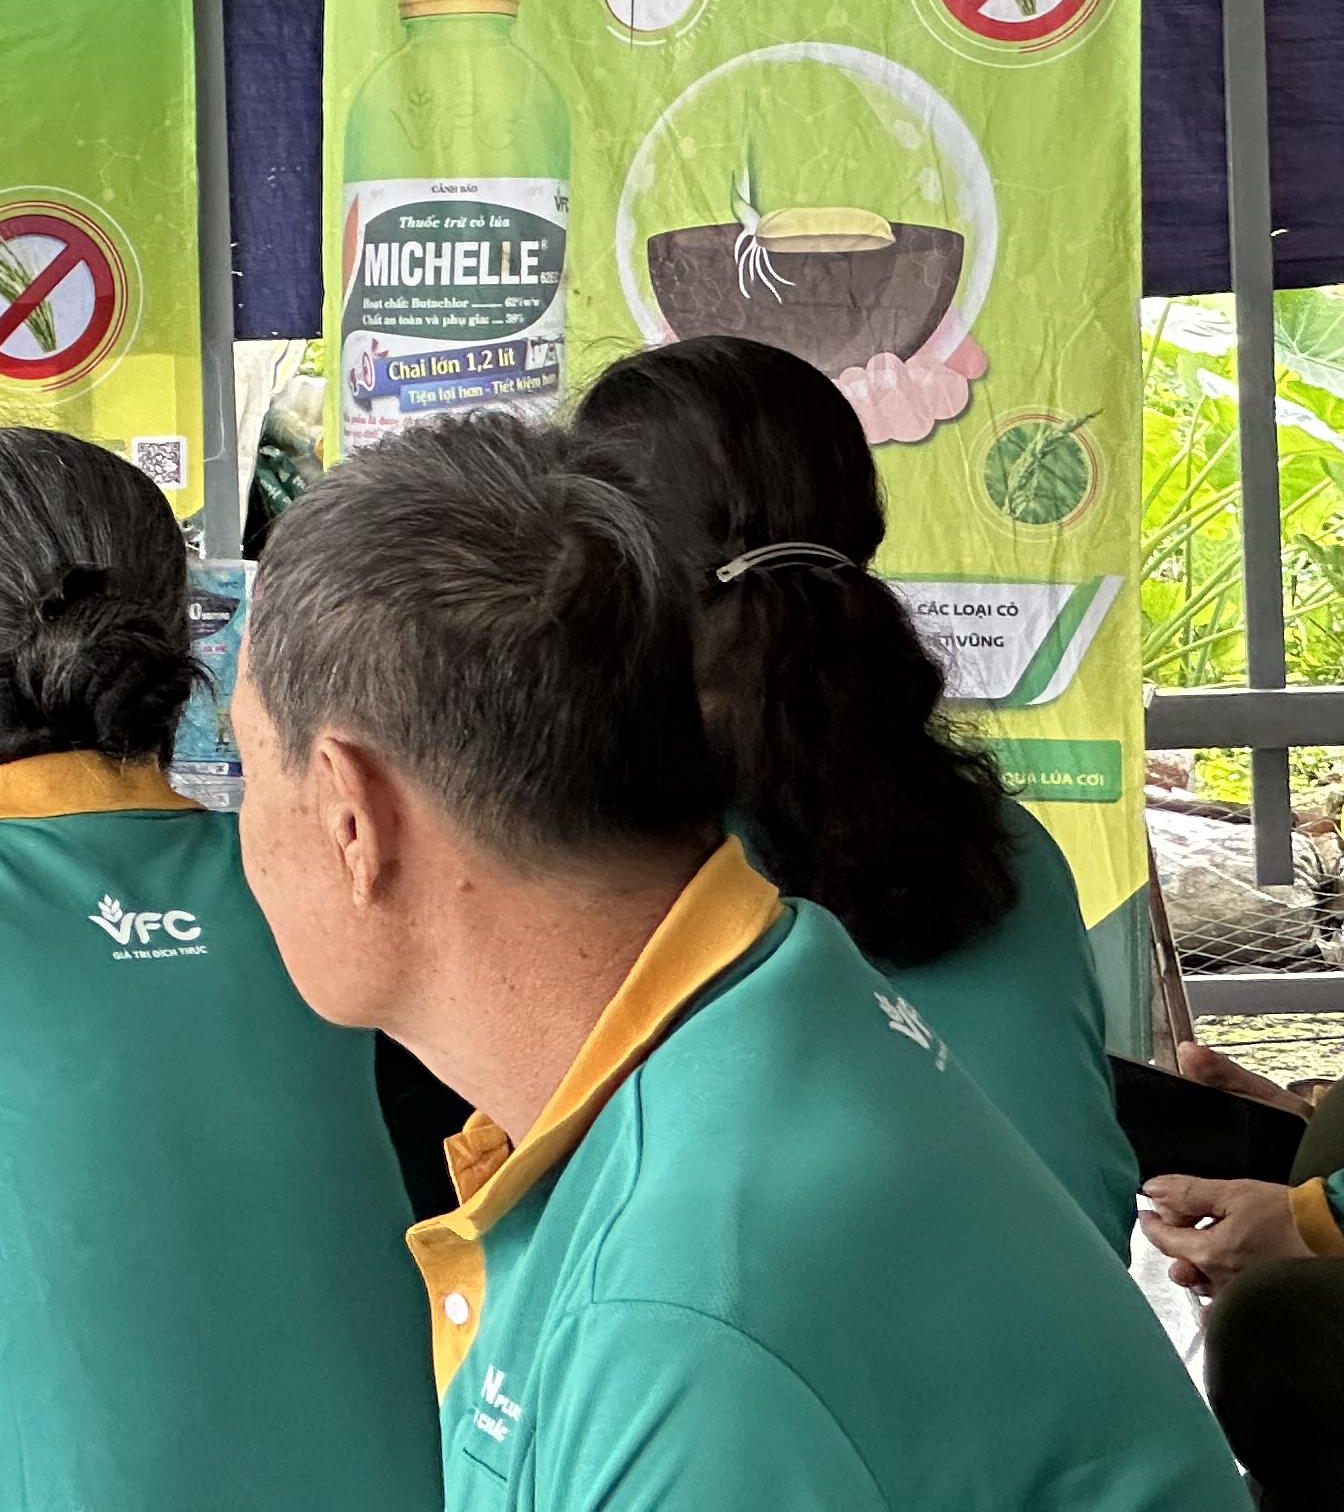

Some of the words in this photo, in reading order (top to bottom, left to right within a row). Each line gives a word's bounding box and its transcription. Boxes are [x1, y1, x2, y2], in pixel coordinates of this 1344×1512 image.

[399, 214, 440, 229] Thuốc
[489, 215, 510, 229] lúa
[388, 360, 426, 381] Chai
[431, 355, 461, 375] lớn
[467, 350, 493, 373] 1,2
[498, 347, 516, 367] lít
[409, 389, 437, 405] Tiện
[491, 380, 515, 397] Tiết
[917, 600, 949, 616] CÁC
[953, 603, 992, 620] LOẠI
[956, 632, 1005, 648] VŨNG
[1041, 768, 1073, 786] LÚA
[88, 910, 202, 945] VFC
